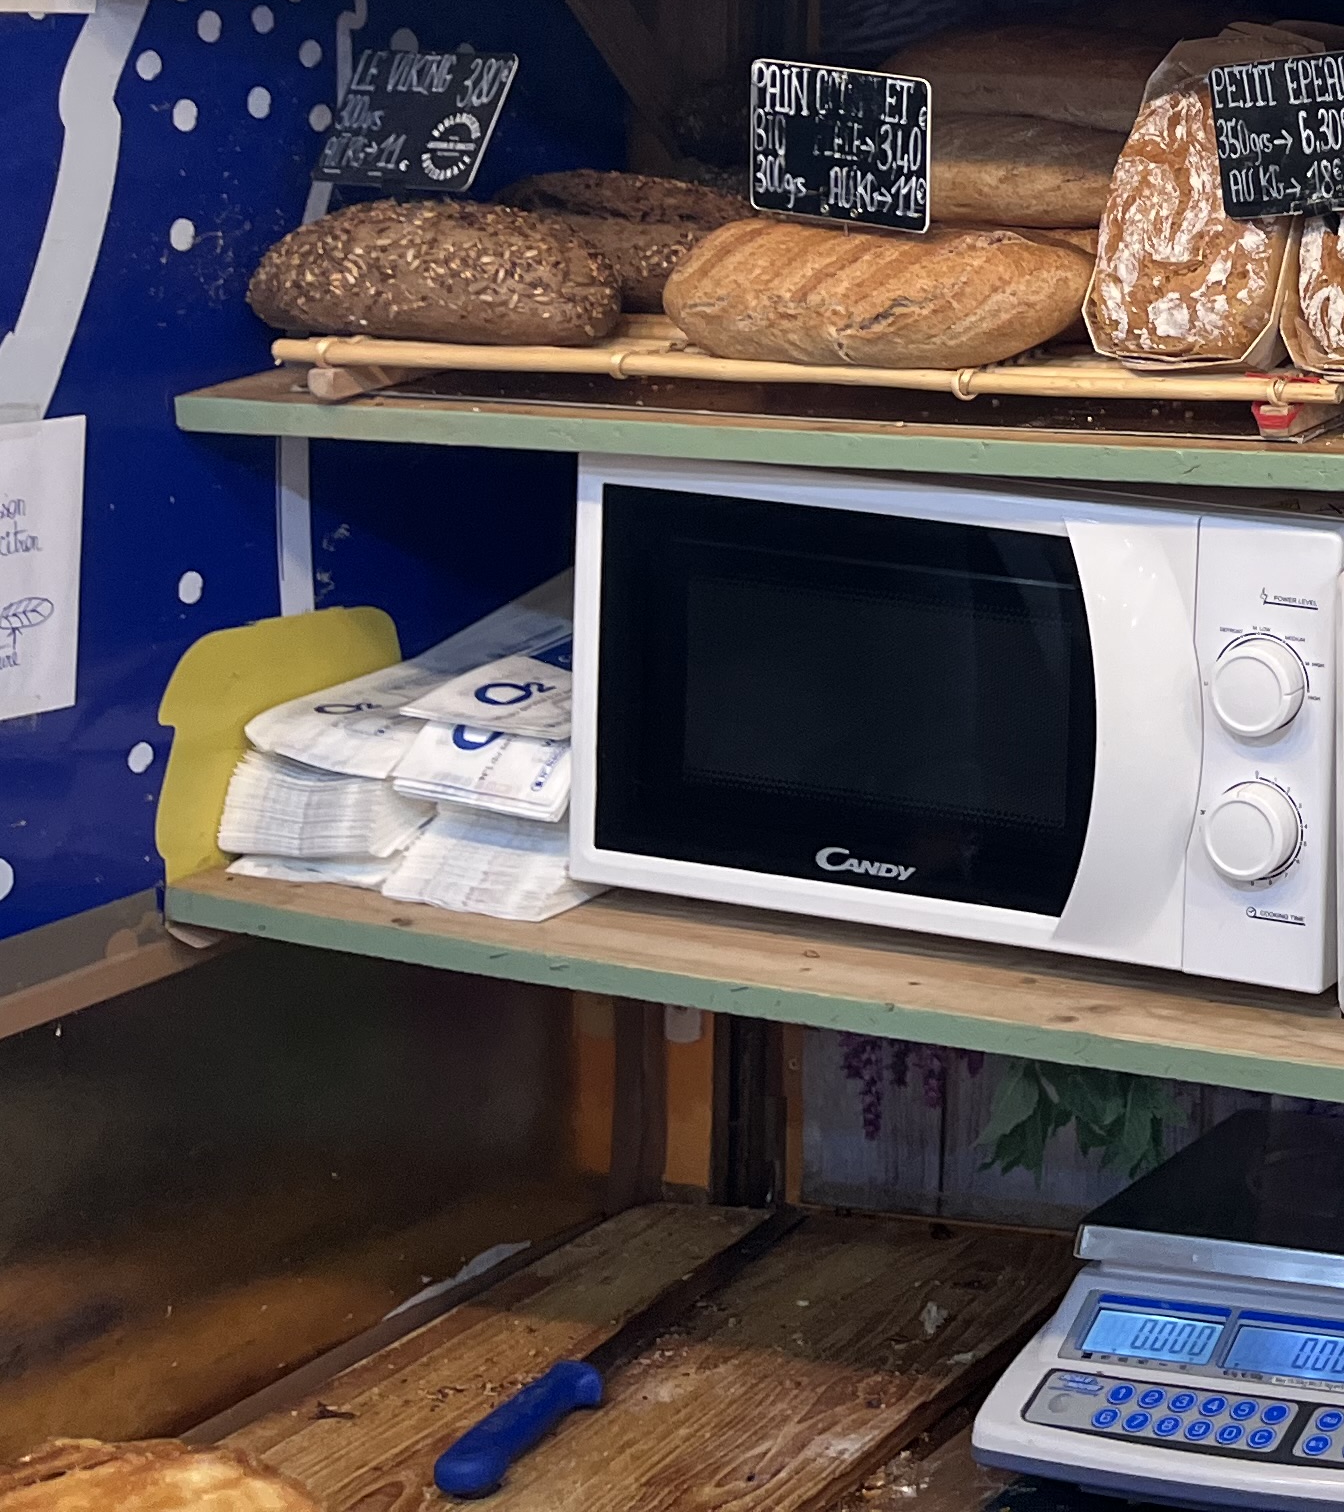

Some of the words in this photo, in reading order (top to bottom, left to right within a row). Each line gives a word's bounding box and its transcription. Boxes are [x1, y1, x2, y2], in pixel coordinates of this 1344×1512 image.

[351, 49, 389, 91] LE
[752, 61, 811, 116] PAIN
[1211, 62, 1278, 109] PETIT
[1229, 167, 1254, 203] AU
[1260, 165, 1286, 201] KG
[1306, 158, 1344, 201] 18€
[1273, 595, 1297, 603] POWER
[1298, 597, 1318, 606] LEVEL
[1117, 1388, 1126, 1398] 1
[1147, 1392, 1159, 1403] 2
[1176, 1396, 1188, 1406] 3
[1207, 1400, 1219, 1411] 4
[1238, 1404, 1250, 1415] 5
[1100, 1411, 1112, 1422] 6
[1133, 1415, 1144, 1426] 7
[1162, 1420, 1174, 1430] 8
[1193, 1423, 1204, 1435] 9
[1224, 1429, 1236, 1439] 0
[1255, 1431, 1269, 1443] C
